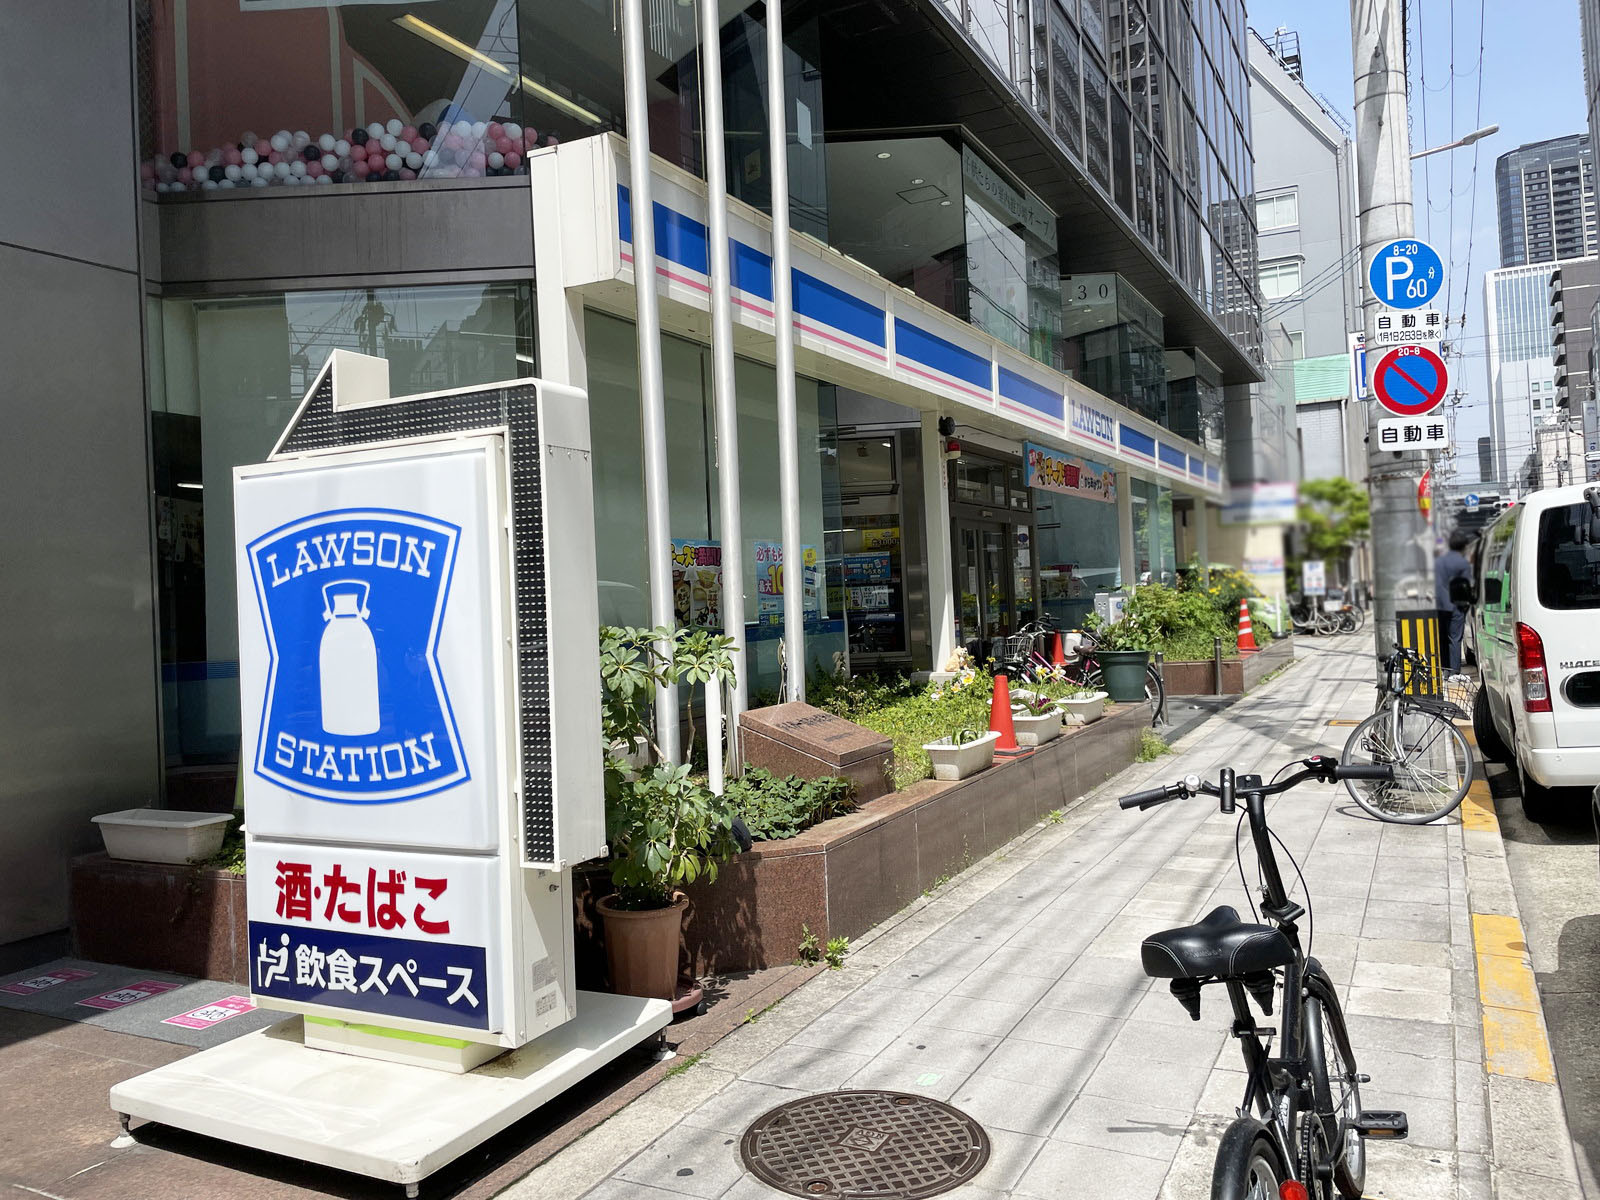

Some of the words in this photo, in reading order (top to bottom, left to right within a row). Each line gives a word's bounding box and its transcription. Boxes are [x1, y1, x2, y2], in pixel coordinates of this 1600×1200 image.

[1393, 244, 1418, 256] 8-20
[1386, 256, 1414, 300] P
[1379, 313, 1440, 329] 自動車
[1398, 347, 1420, 356] 20-8
[1072, 400, 1113, 442] LAWSON
[1382, 424, 1445, 443] 自動車
[266, 531, 436, 588] LAWSON
[1559, 660, 1600, 669] HIACE
[275, 732, 441, 782] STATION
[275, 860, 450, 934] 酒・たばこ
[295, 944, 480, 1008] 飲食スペース
